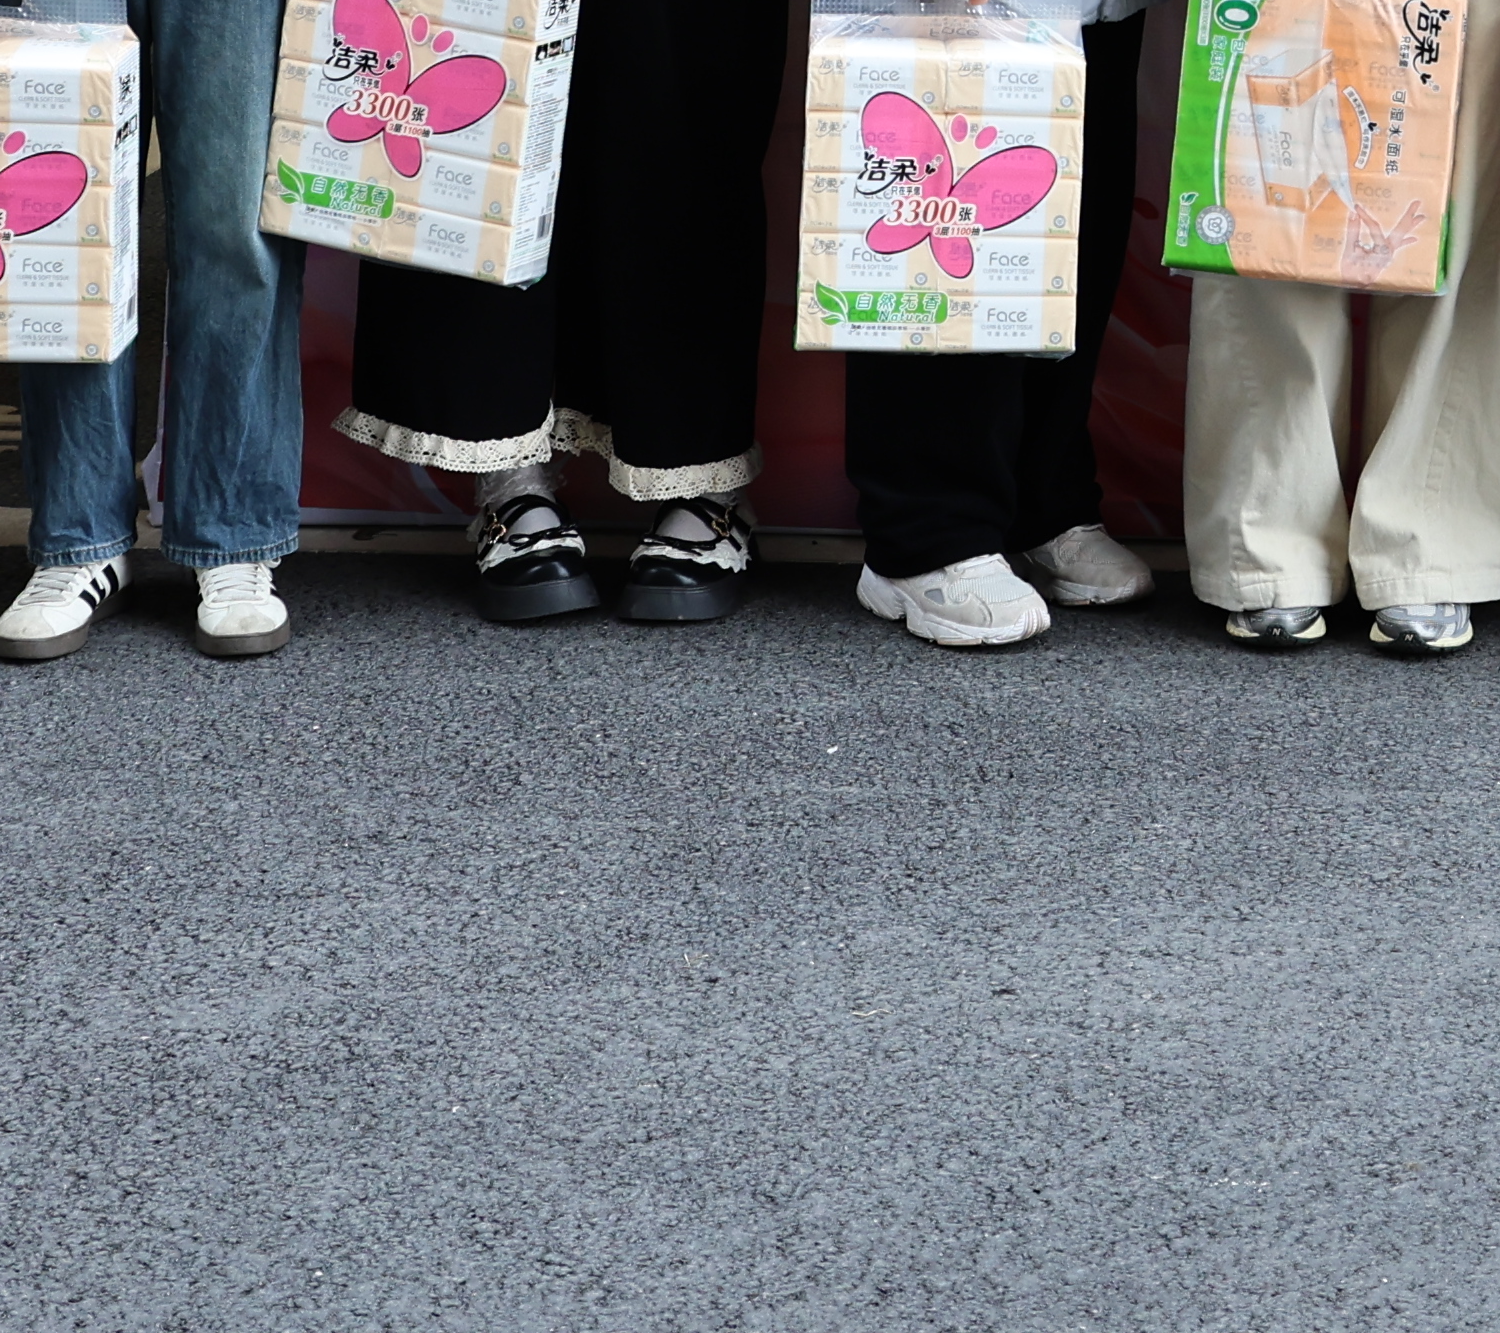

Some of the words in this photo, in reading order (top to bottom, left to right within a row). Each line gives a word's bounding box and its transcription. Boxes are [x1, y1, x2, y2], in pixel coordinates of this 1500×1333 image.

[859, 66, 900, 82] Face
[998, 69, 1038, 85] Face
[24, 79, 65, 95] Face
[346, 89, 426, 123] 3300张
[1385, 91, 1406, 175] 可湿水面纸
[312, 143, 349, 162] Face
[435, 165, 472, 185] Face
[310, 177, 389, 205] 自然无香
[330, 195, 383, 217] Natural
[886, 200, 972, 224] 3300张
[428, 224, 466, 244] Face
[21, 258, 63, 273] Face
[989, 252, 1029, 267] Face
[856, 293, 941, 310] 自然无香
[878, 310, 935, 322] Natural
[987, 308, 1027, 324] Face
[21, 318, 62, 334] Face
